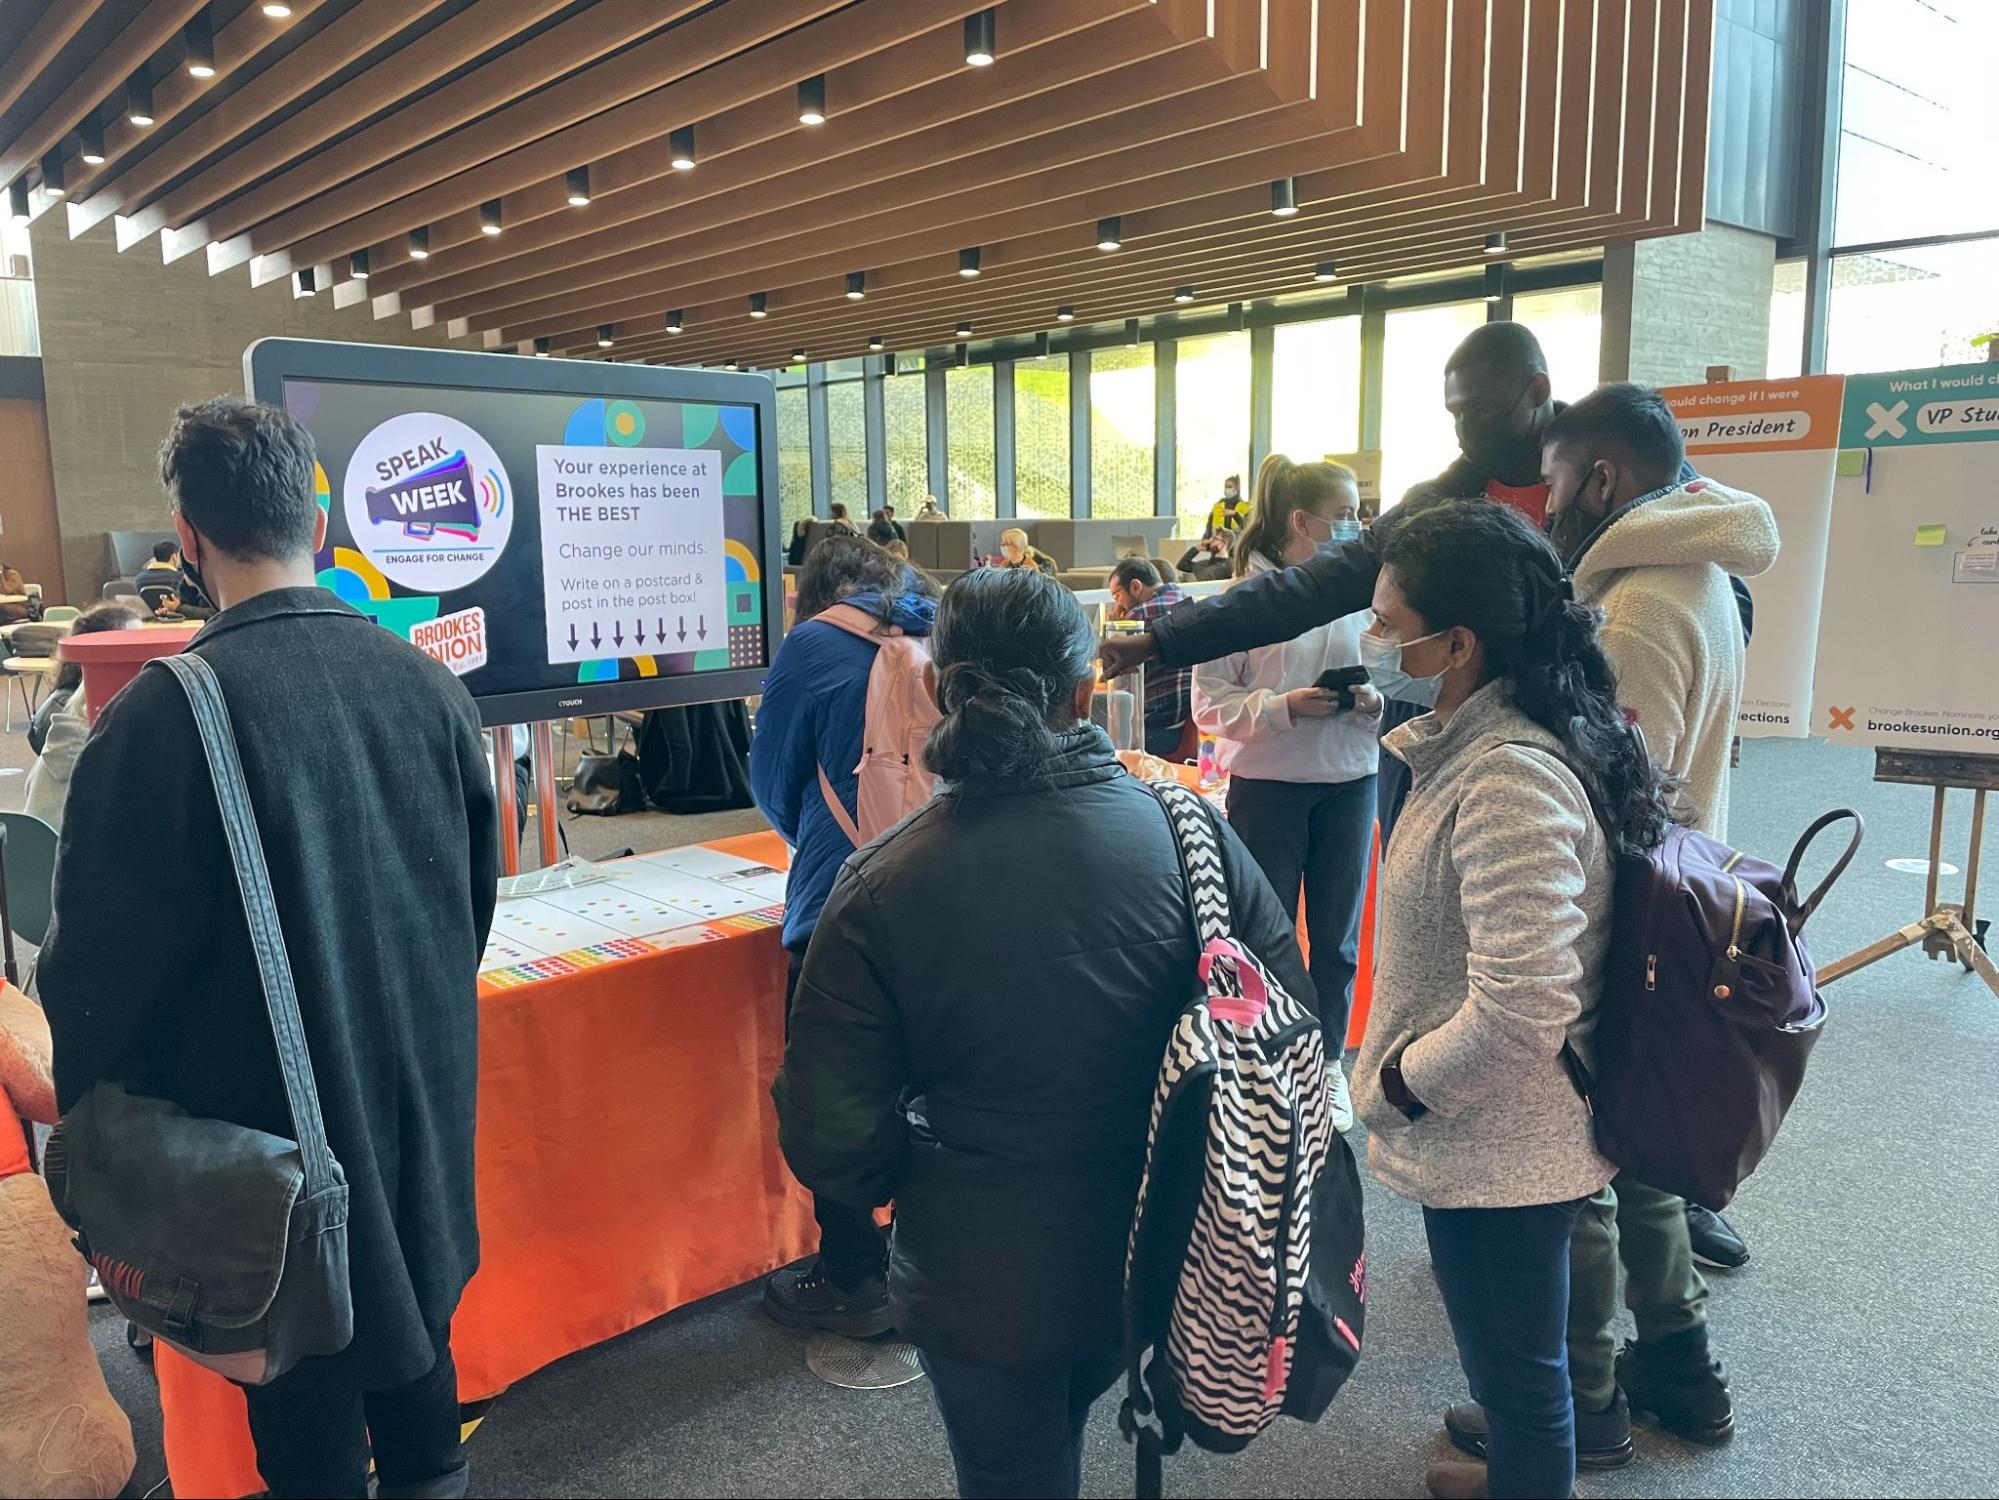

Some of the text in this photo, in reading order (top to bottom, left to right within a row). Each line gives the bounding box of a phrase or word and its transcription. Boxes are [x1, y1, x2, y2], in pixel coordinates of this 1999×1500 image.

[1890, 379, 1928, 392] What
[1932, 378, 1937, 389] I
[1940, 375, 1984, 388] would
[1670, 395, 1696, 407] ould
[1699, 393, 1746, 405] change
[1760, 390, 1765, 400] I
[1768, 389, 1800, 399] were
[1927, 408, 1953, 425] VP
[1707, 418, 1797, 437] President
[376, 436, 449, 481] SPEAK
[554, 459, 707, 477] Your experience at
[390, 480, 467, 515] WEEK
[556, 483, 700, 498] Brookes has been
[557, 507, 640, 521] THE BEST
[386, 552, 485, 564] ENGAGE FOR CHANGE
[559, 540, 708, 560] Change our minds.
[561, 573, 704, 591] Write on a postcard &
[562, 591, 696, 613] post in the post box!
[414, 612, 481, 647] BROOKES
[425, 633, 481, 662] NION
[1868, 706, 1903, 717] Change
[1943, 709, 1985, 720] Nominate
[1868, 719, 1999, 740] brookesunion.org
